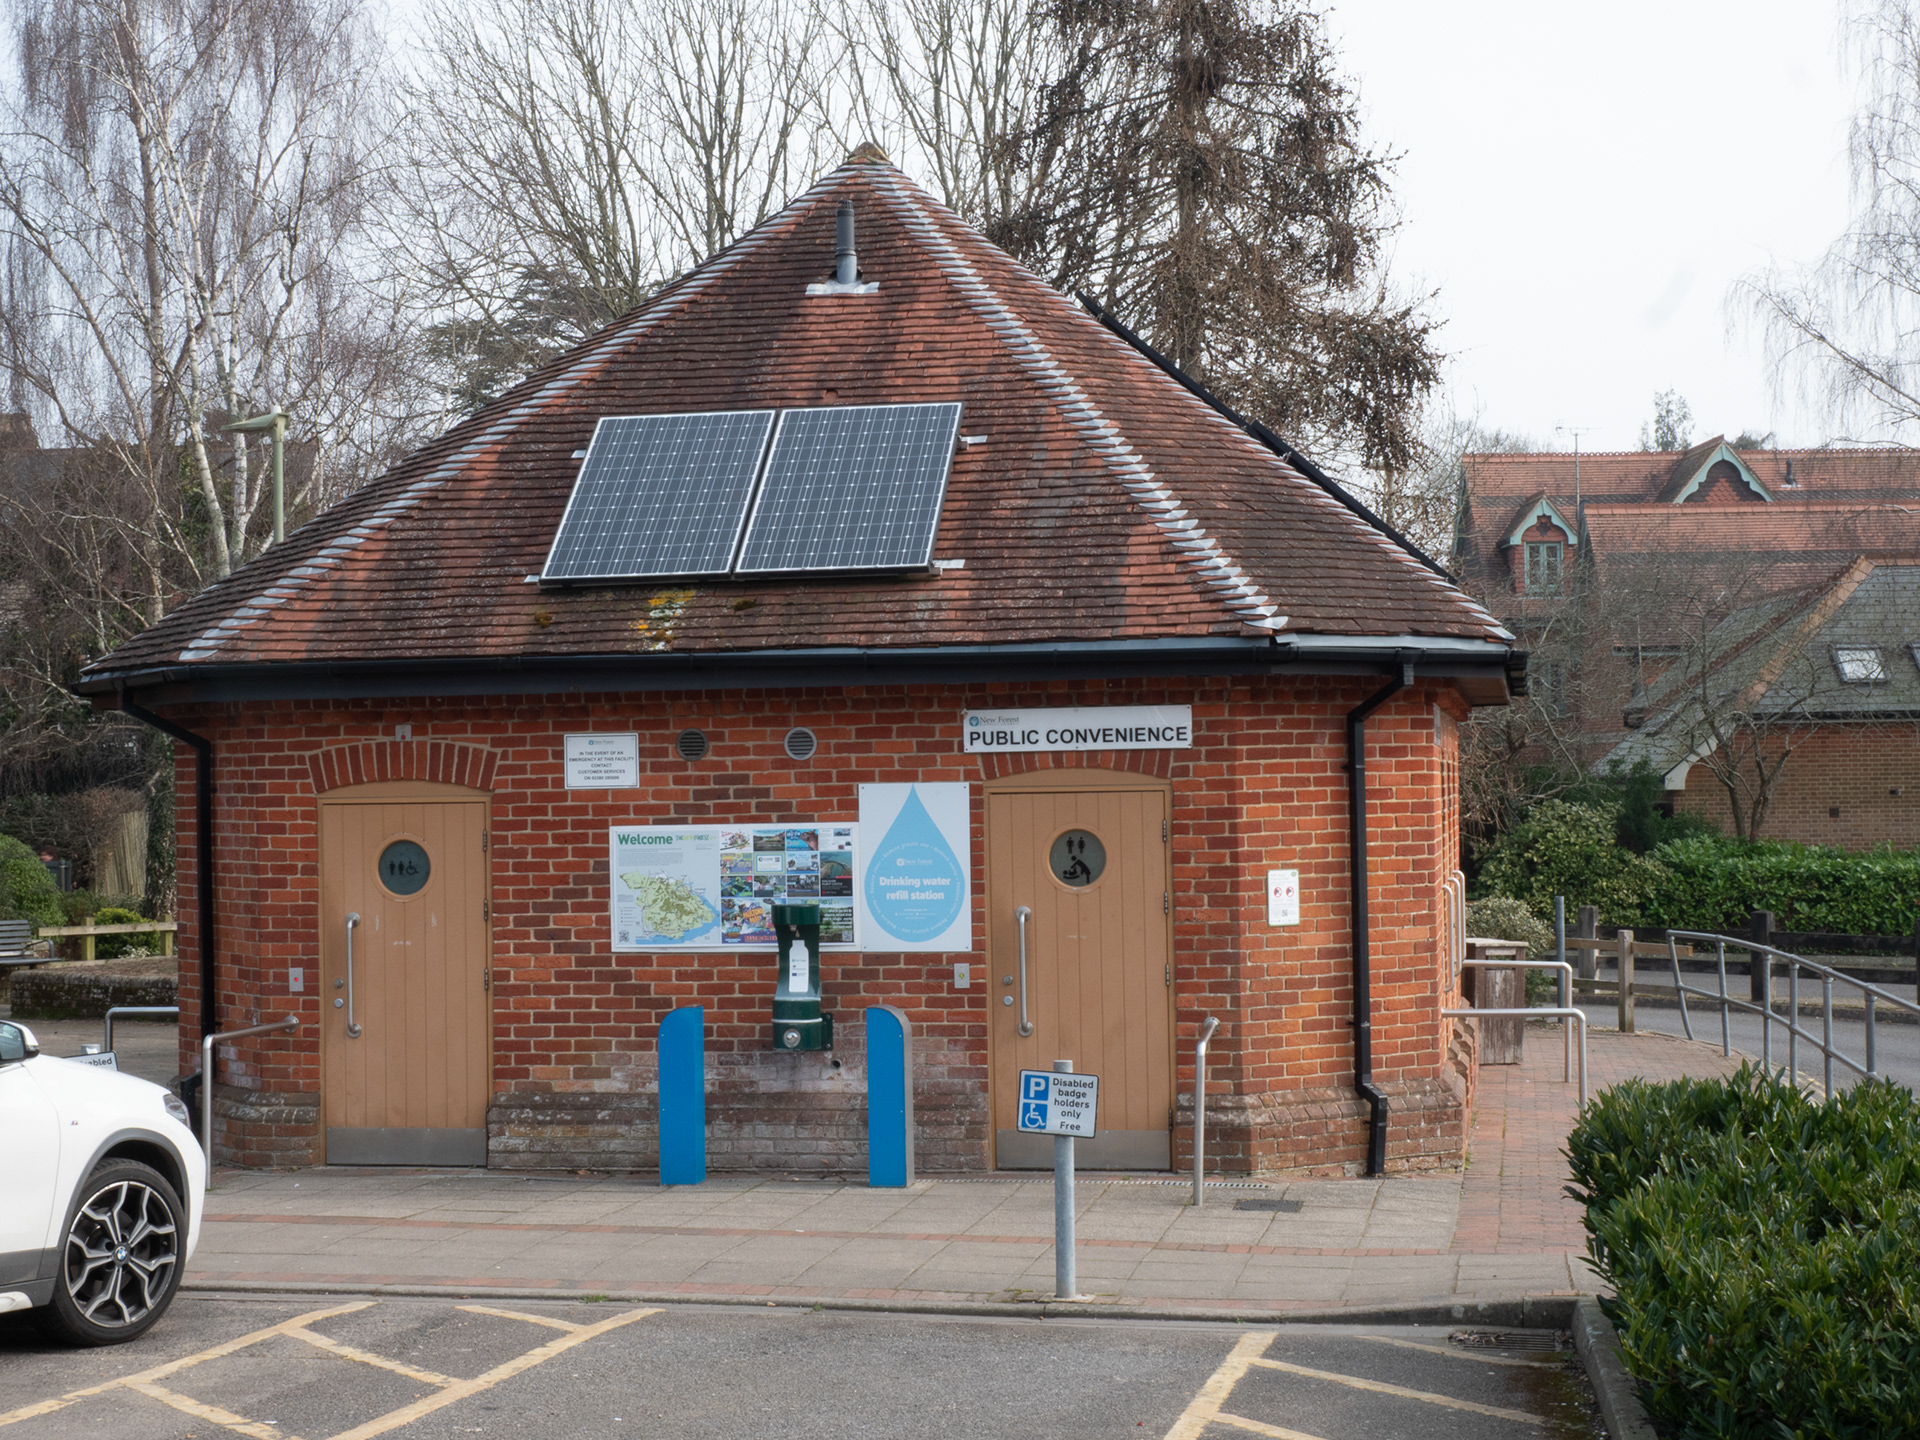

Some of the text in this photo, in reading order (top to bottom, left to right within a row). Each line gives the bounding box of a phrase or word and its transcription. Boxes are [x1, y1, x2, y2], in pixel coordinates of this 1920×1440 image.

[998, 715, 1019, 723] Forest
[970, 726, 1188, 746] PUBLIC CONVENIENCE
[618, 834, 673, 845] Welcome
[879, 876, 951, 888] Drinking water
[886, 890, 944, 900] refill station
[1029, 1078, 1094, 1098] P Disabled
[1058, 1089, 1087, 1099] badge
[1054, 1098, 1090, 1108] holders
[1061, 1110, 1081, 1119] only
[1060, 1122, 1081, 1130] Free
